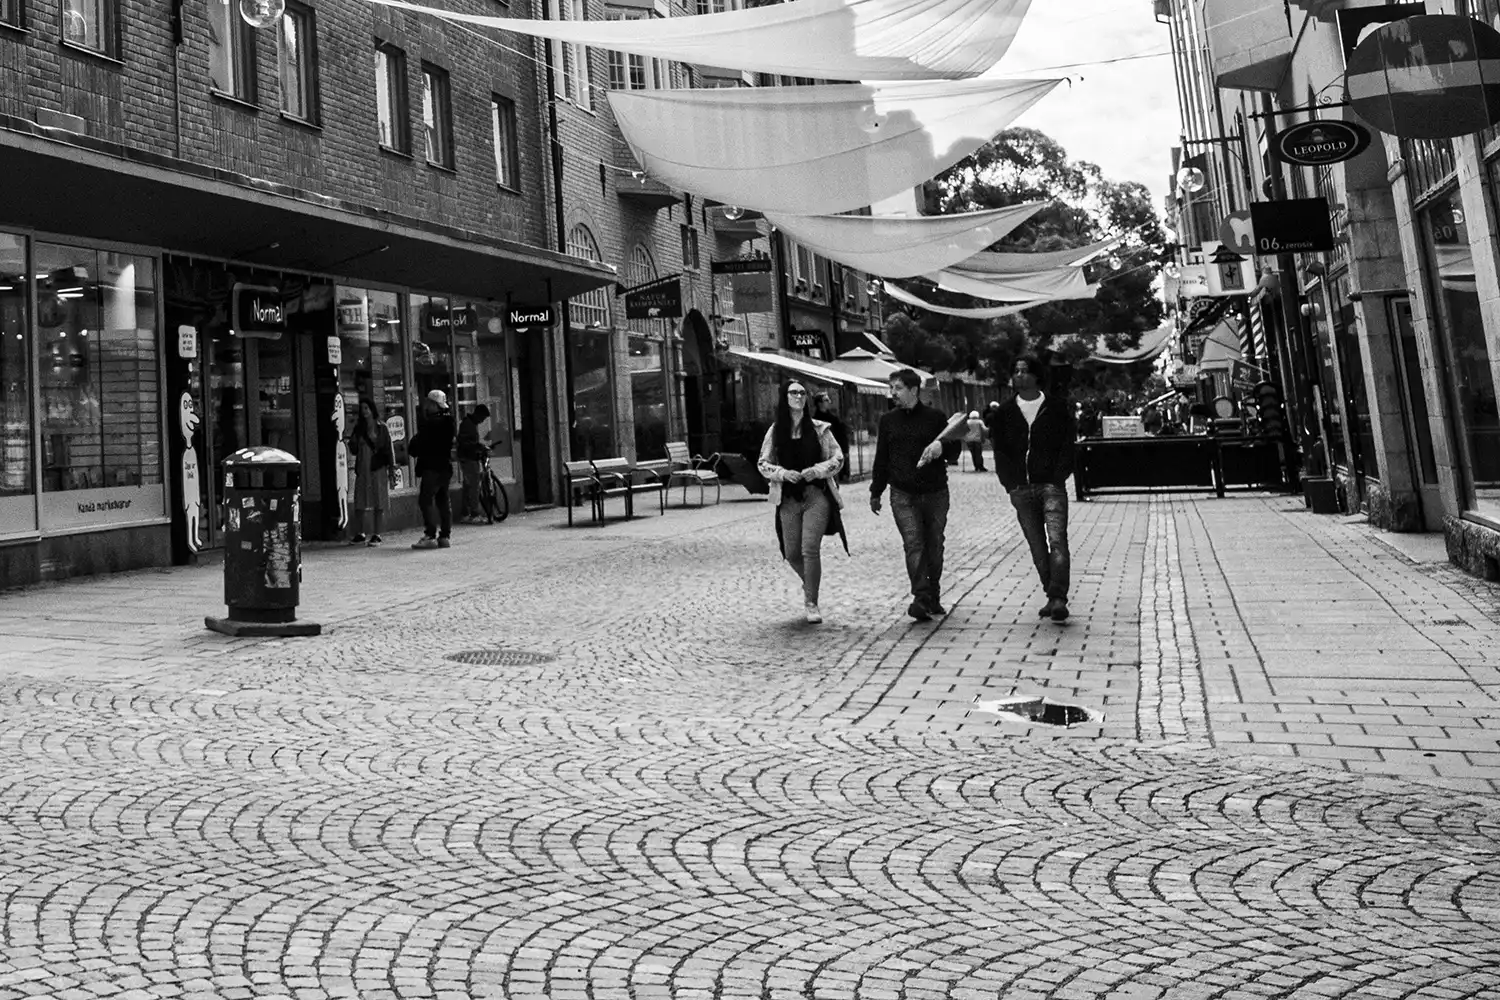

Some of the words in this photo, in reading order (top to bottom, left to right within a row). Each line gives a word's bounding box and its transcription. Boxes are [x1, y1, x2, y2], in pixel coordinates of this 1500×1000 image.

[1293, 141, 1347, 155] LEOPOLD
[253, 296, 283, 322] Normal
[510, 309, 549, 323] Normal
